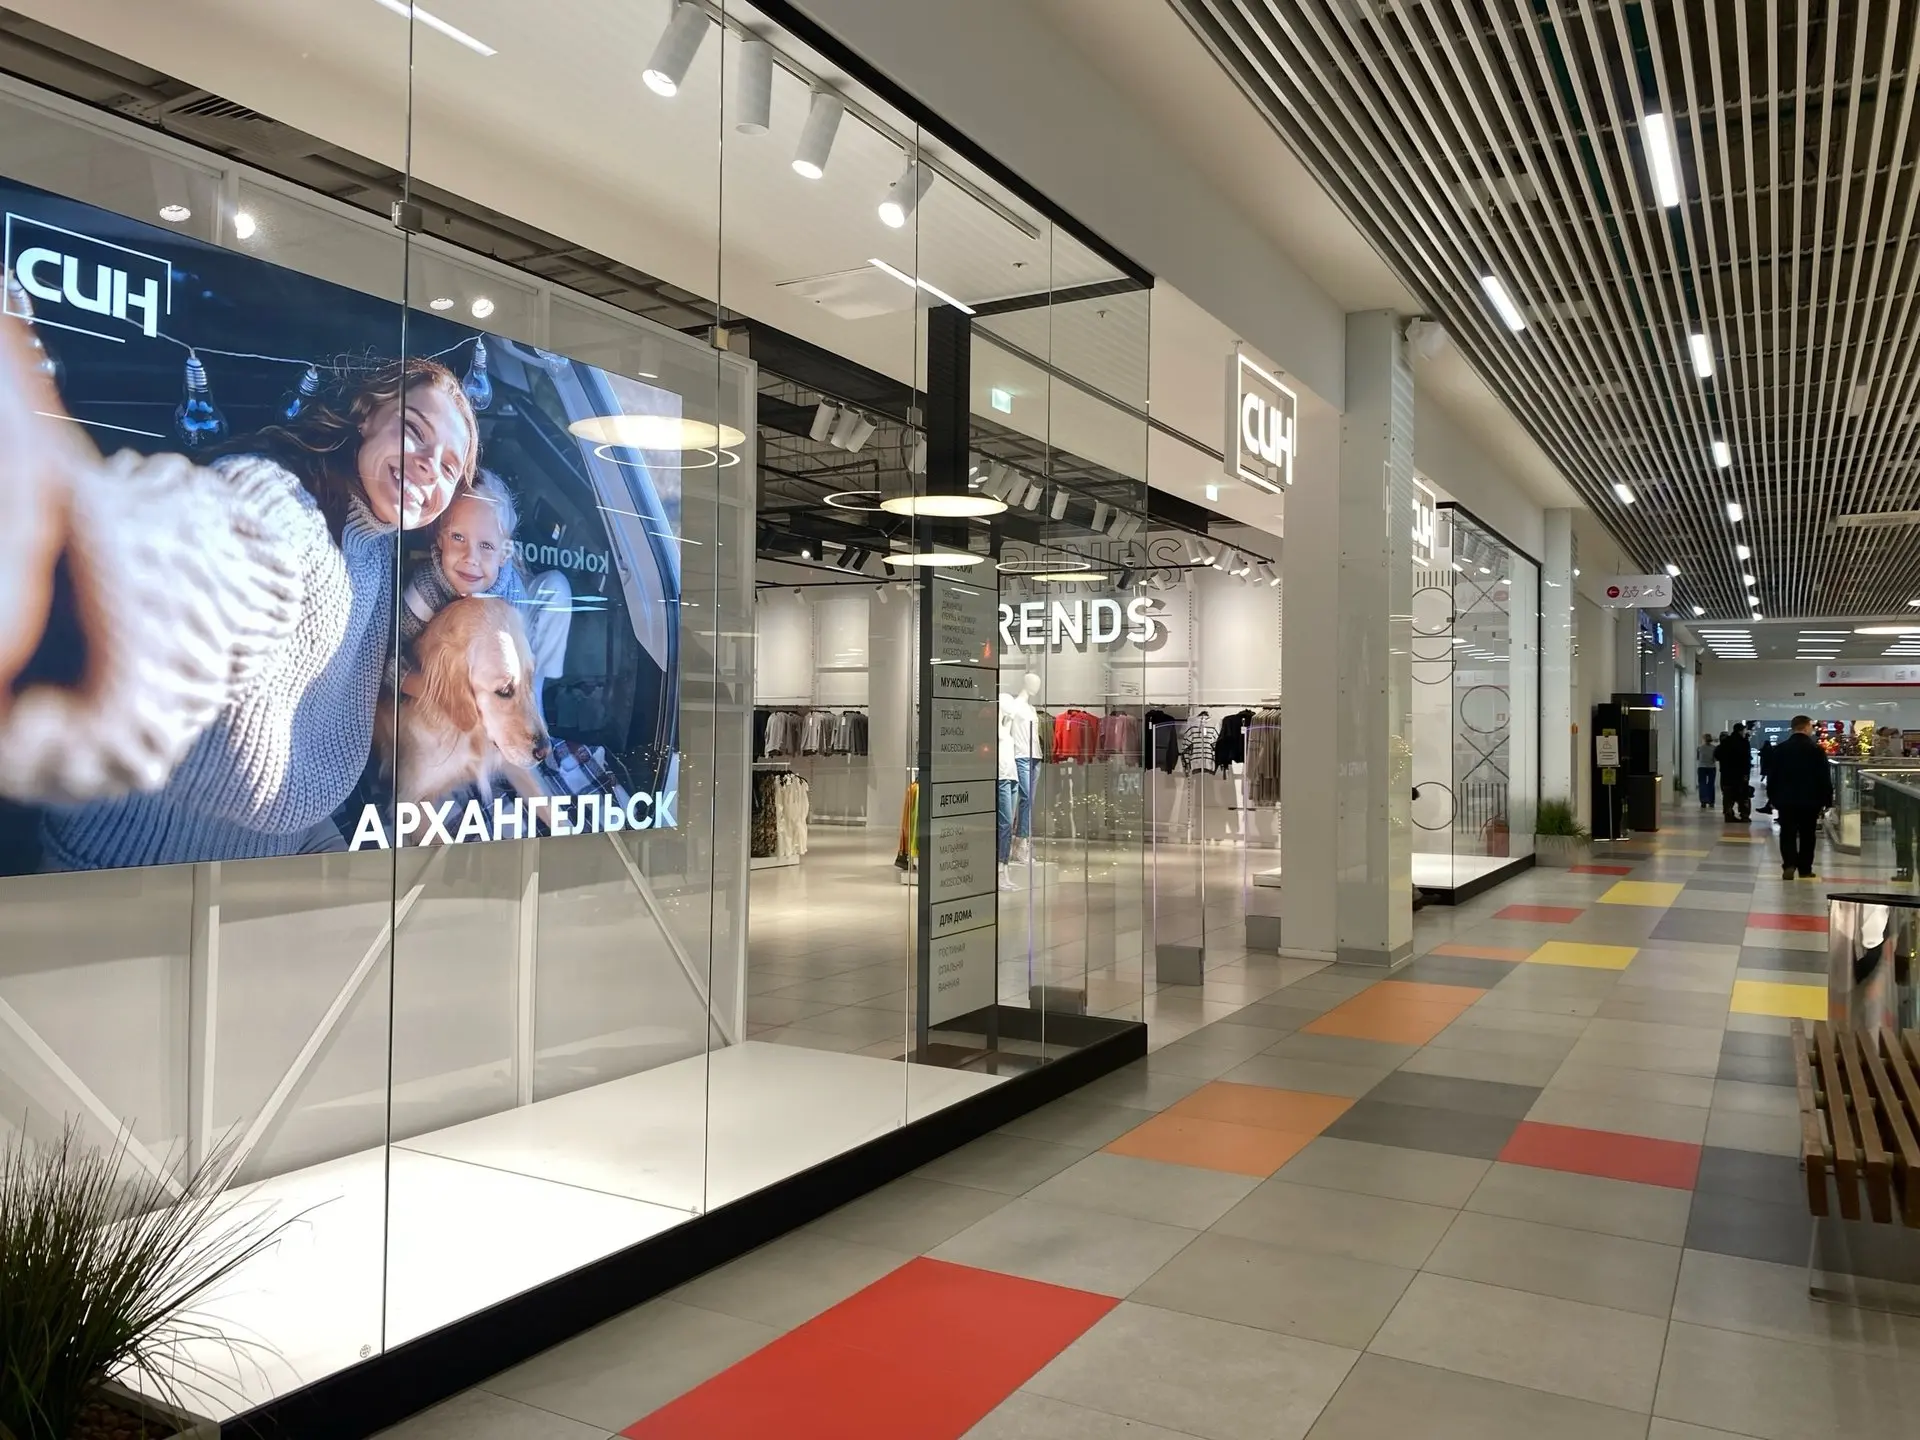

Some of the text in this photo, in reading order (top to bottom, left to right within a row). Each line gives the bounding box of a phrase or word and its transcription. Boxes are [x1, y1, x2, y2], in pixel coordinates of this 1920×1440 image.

[16, 247, 158, 338] СИН
[1242, 392, 1292, 485] СИН
[941, 676, 973, 689] МУЖСКОЙ
[941, 709, 962, 720] ТРЕНДЫ
[940, 743, 975, 753] АКСЕССУАРЫ
[940, 791, 969, 807] ДЕТСКИЙ
[348, 790, 678, 852] АРХАНГЕЛЬСК
[939, 908, 973, 928] ДЛЯ ДОМА
